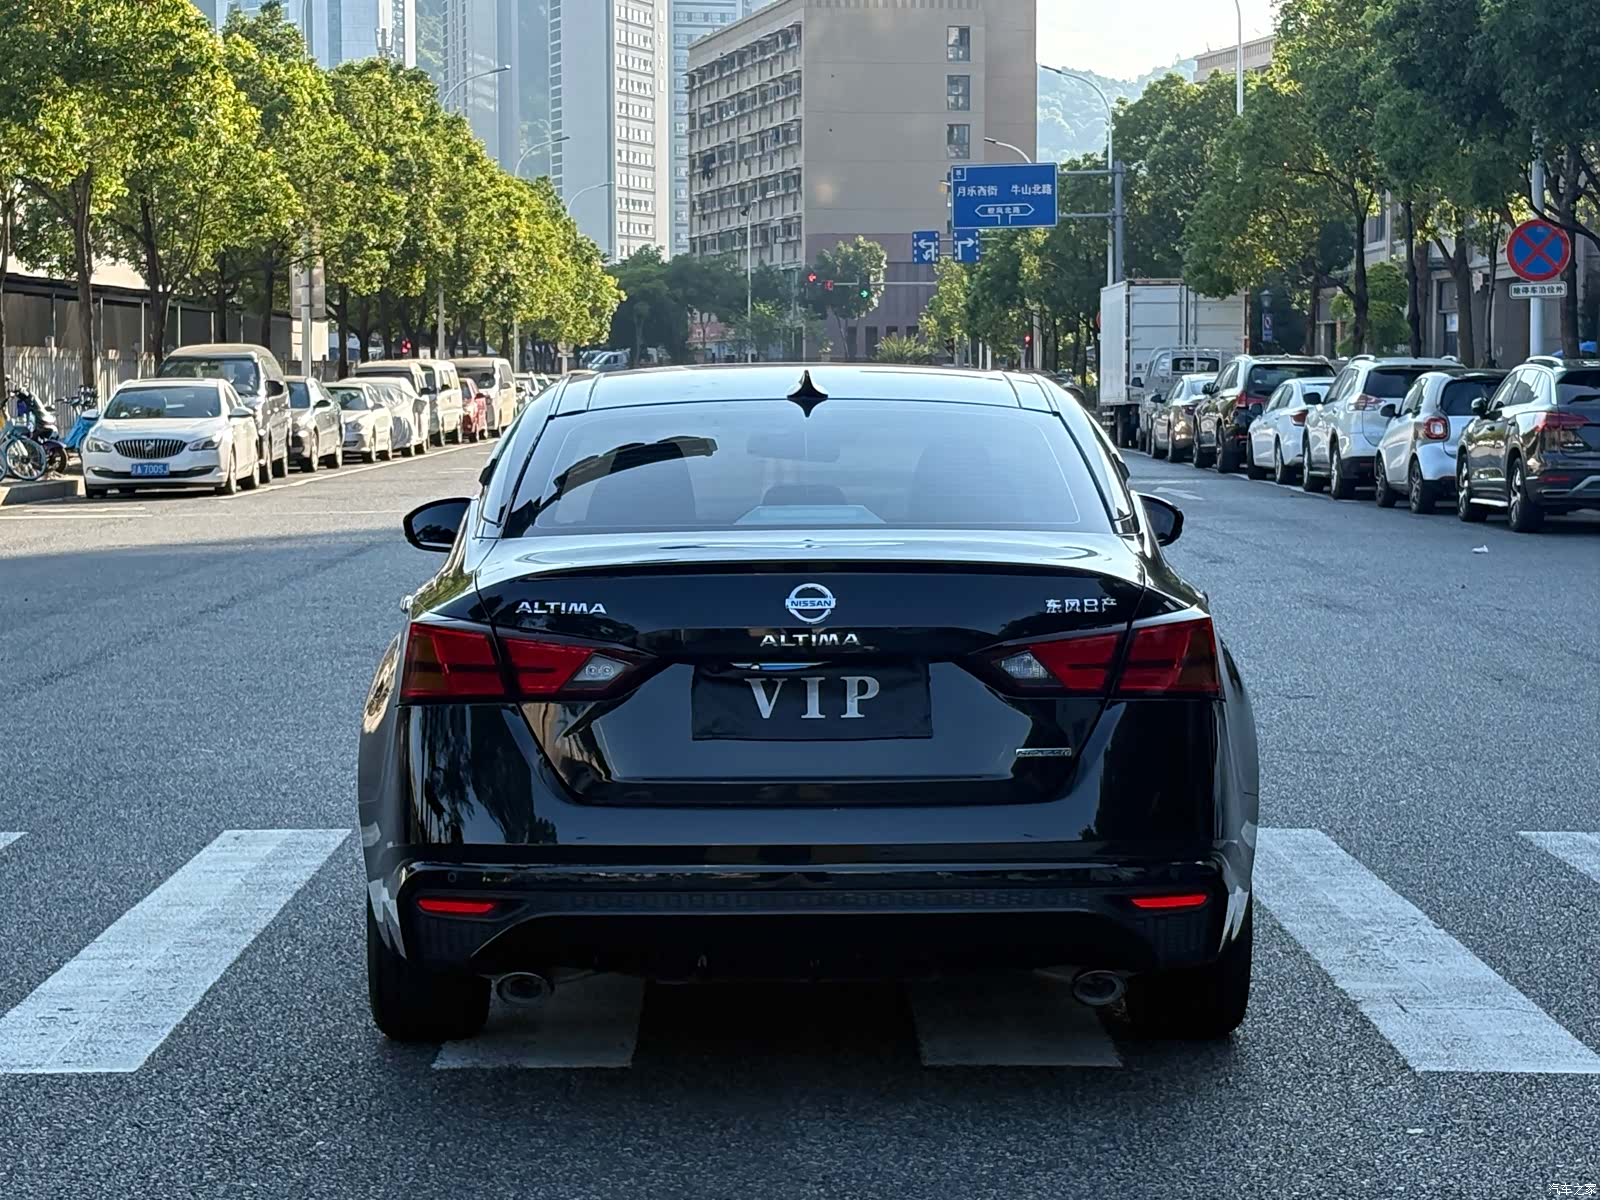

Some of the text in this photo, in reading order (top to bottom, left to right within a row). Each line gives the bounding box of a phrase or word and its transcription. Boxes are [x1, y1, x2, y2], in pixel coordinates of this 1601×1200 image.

[956, 185, 998, 197] 月乐西街
[1010, 184, 1052, 195] 牛山北路
[515, 601, 607, 614] ALTIMA
[1045, 597, 1117, 613] 东风日产
[760, 633, 860, 647] ALTIMA
[744, 676, 880, 719] VIP
